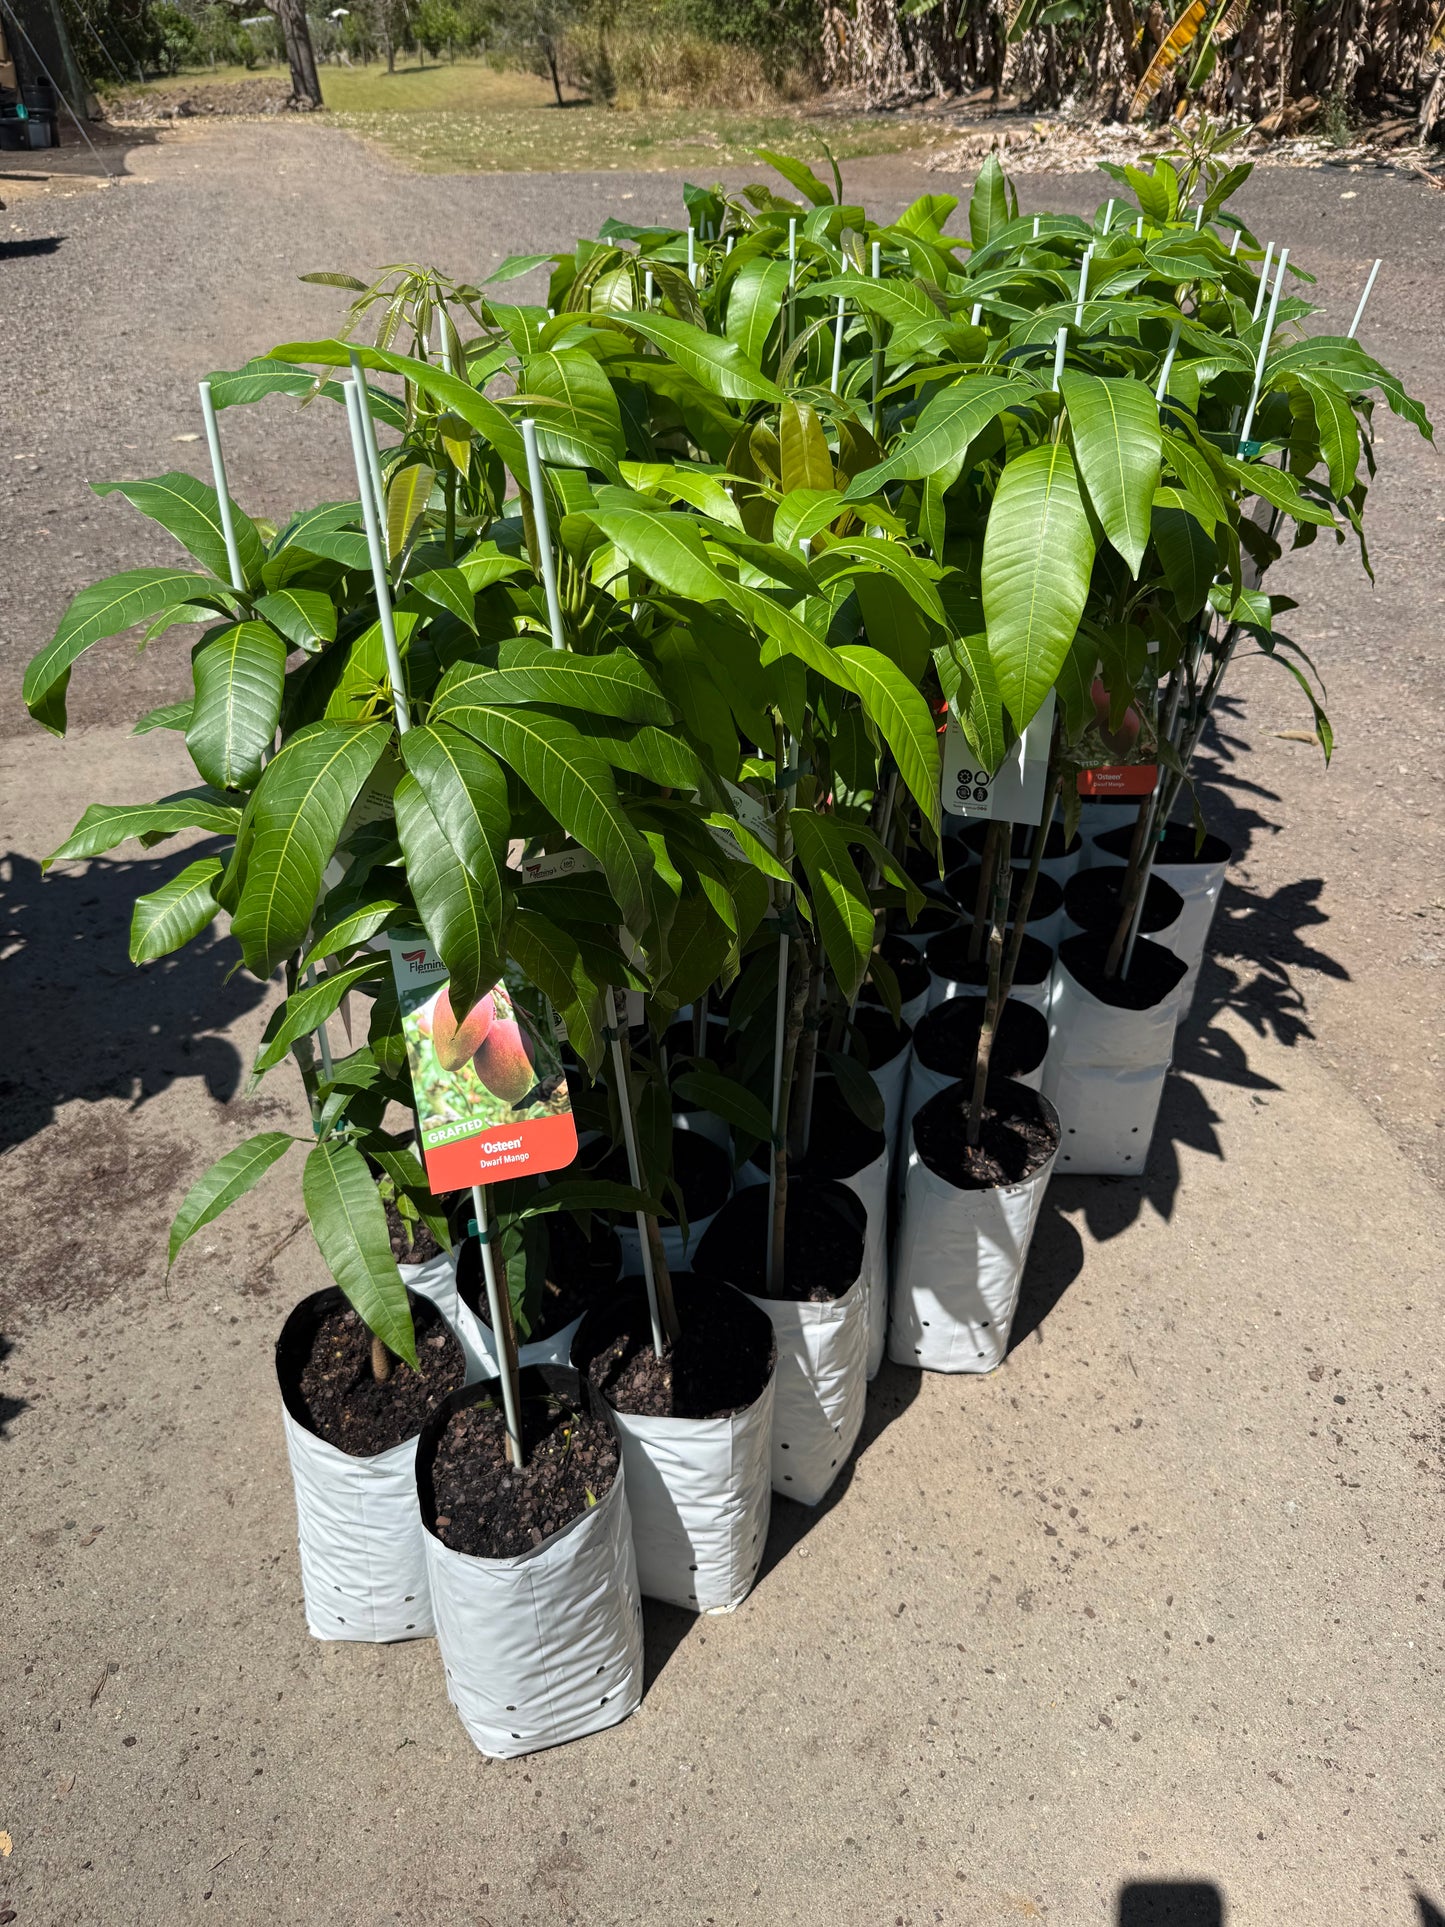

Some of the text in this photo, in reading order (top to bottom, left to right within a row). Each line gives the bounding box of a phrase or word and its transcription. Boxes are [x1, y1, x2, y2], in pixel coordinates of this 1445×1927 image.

[427, 1118, 483, 1144] GRAFTED
[480, 1152, 530, 1169] Dwarf Mango
